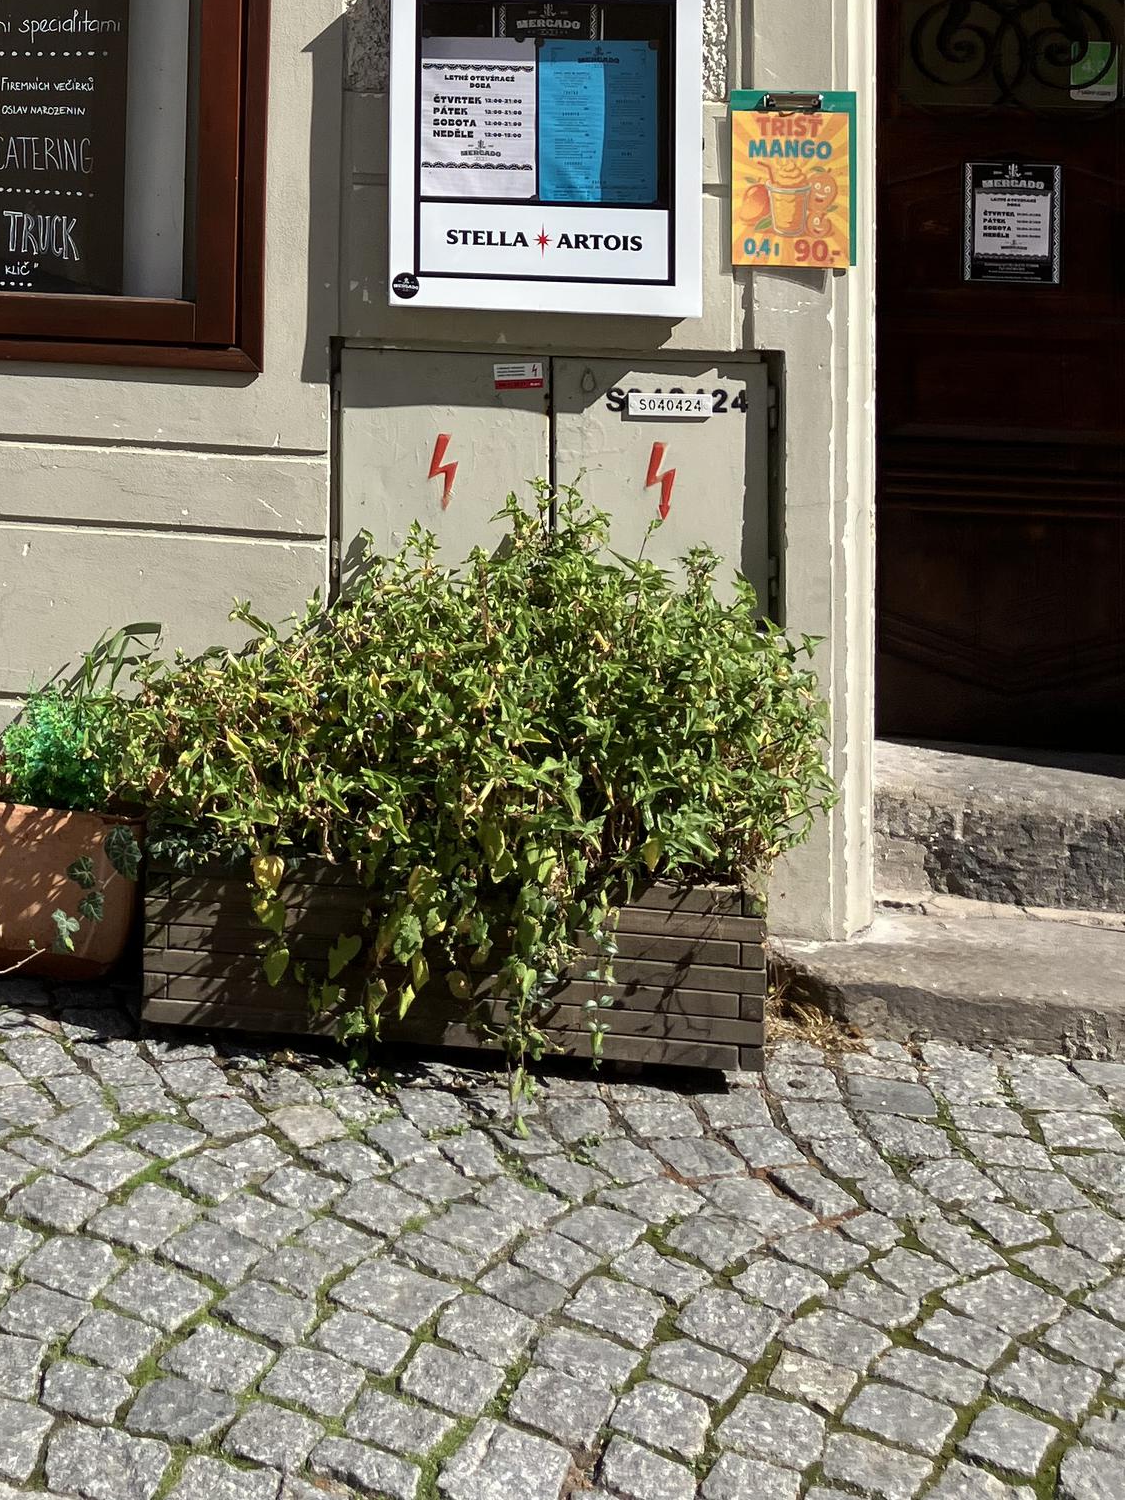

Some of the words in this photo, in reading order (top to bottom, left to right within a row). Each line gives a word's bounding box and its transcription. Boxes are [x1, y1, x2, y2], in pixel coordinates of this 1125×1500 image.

[18, 9, 121, 43] specialitami
[516, 19, 581, 29] MERCADO
[433, 94, 482, 104] ČTVRTEK
[1, 105, 28, 115] OSLAV
[30, 105, 86, 115] NAROZENIN
[433, 105, 468, 115] PÁTEK
[433, 118, 477, 127] SOBOTA
[433, 129, 474, 138] NEDĚLE
[460, 149, 501, 157] MERCADO
[748, 139, 833, 160] MANGO
[981, 180, 1045, 190] MERCADO
[3, 210, 80, 261] TRUCK
[446, 229, 529, 247] STELLA
[556, 232, 643, 251] ARTOIS
[639, 399, 702, 412] S040424
